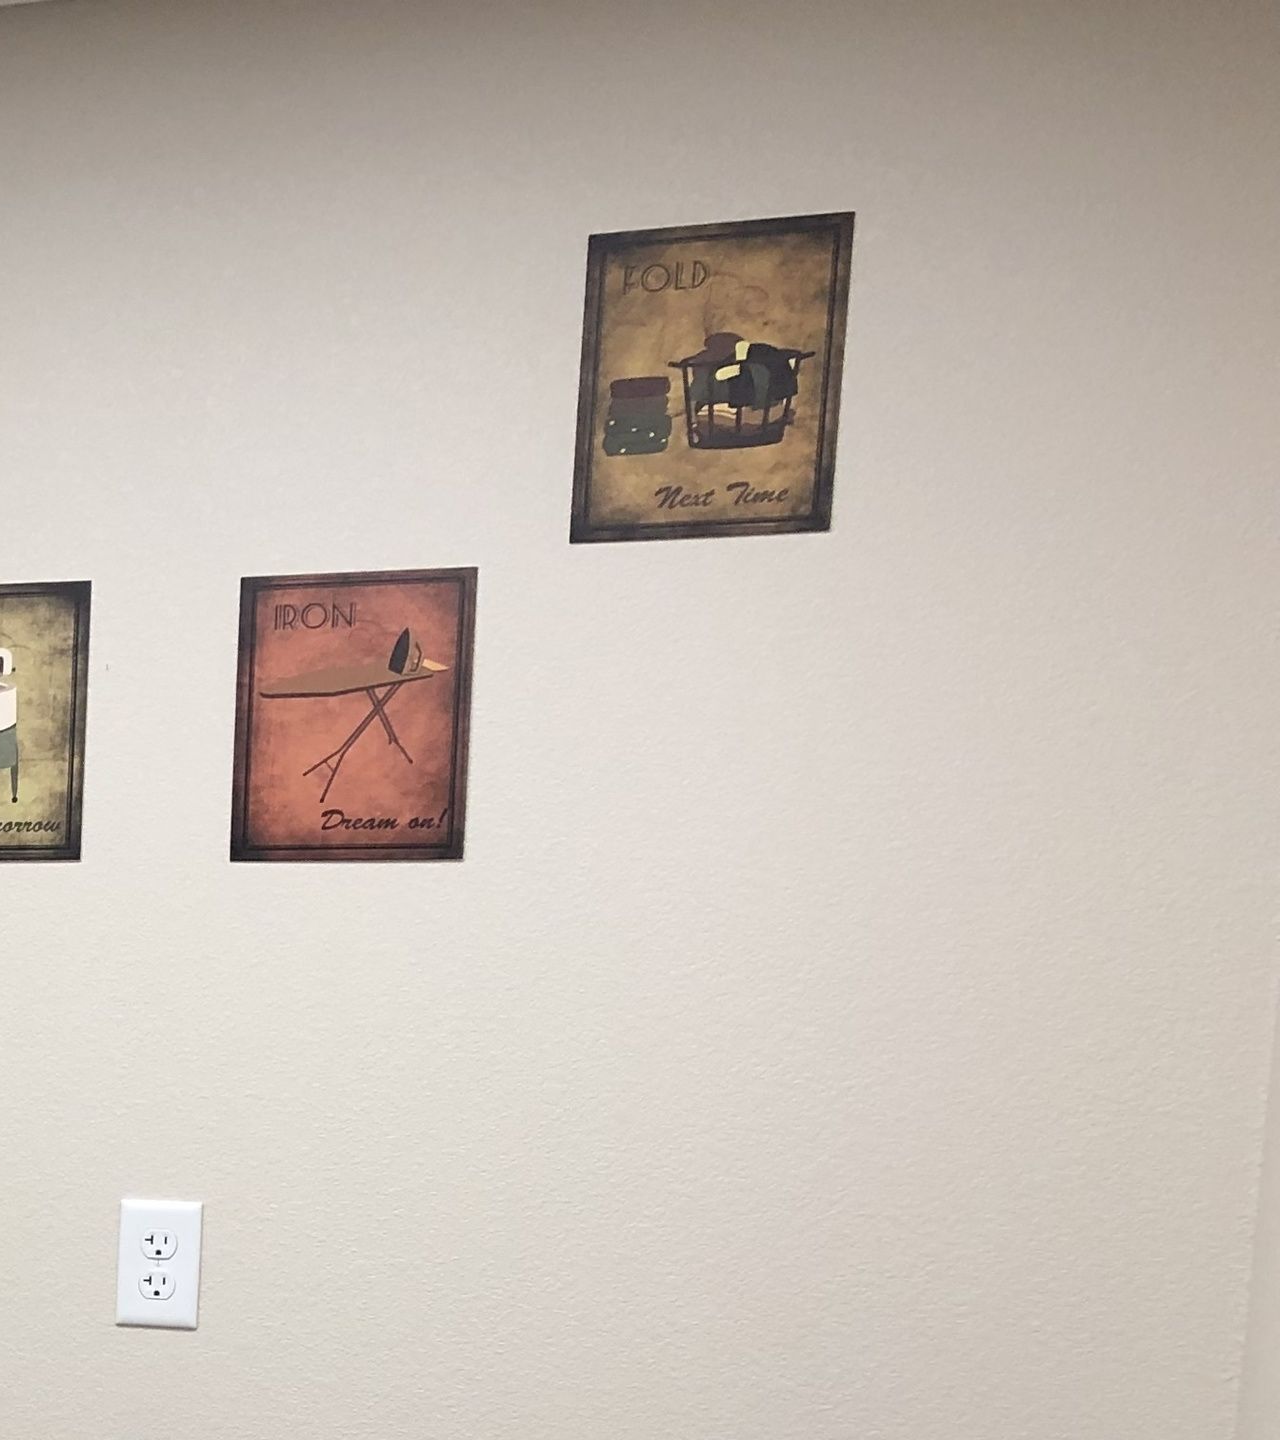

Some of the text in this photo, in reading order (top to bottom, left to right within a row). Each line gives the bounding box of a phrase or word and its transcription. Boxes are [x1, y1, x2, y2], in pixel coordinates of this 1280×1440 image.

[623, 260, 709, 295] FOLD
[654, 481, 790, 510] Next Time
[274, 602, 357, 630] IRON
[320, 808, 448, 831] Dream on!
